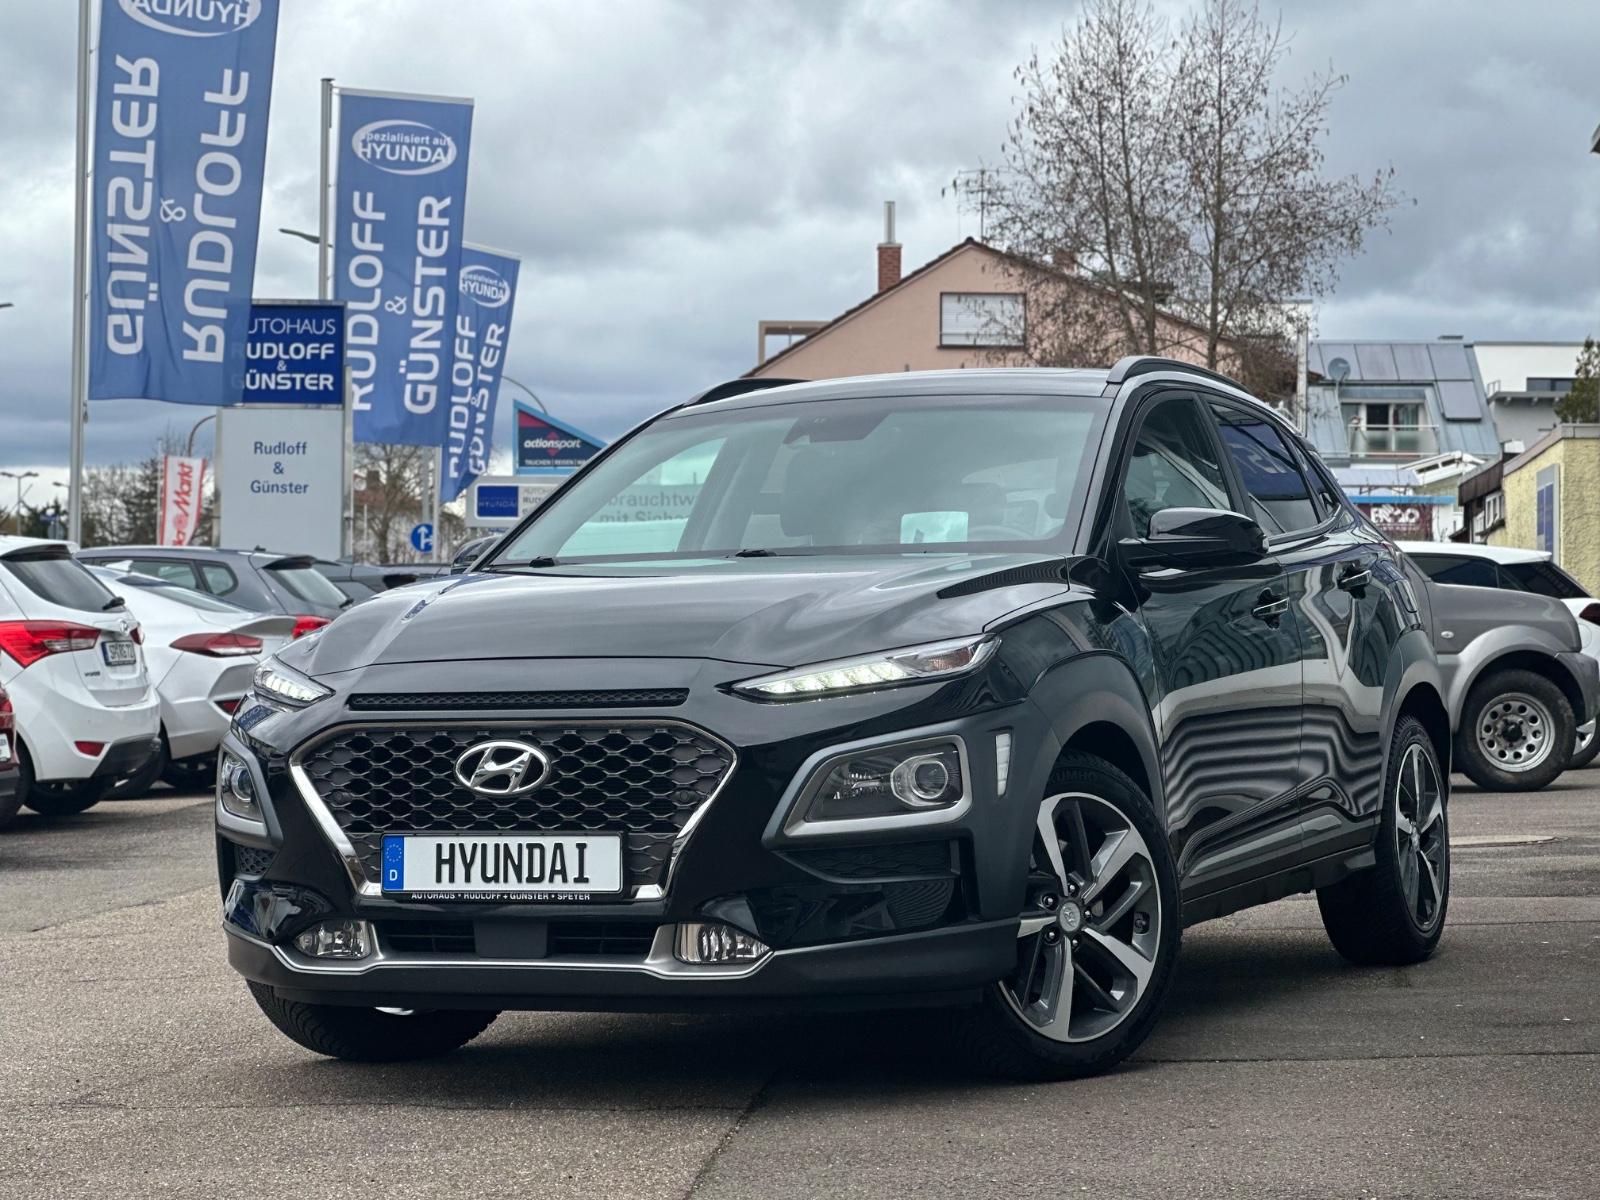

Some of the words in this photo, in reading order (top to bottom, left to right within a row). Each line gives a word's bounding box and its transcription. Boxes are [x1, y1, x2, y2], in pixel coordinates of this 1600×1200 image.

[346, 190, 386, 411] RUDLOFF
[384, 295, 407, 316] &
[399, 195, 452, 414] GÜNSTER
[247, 318, 336, 335] UTOHAUS
[245, 342, 335, 360] UDLOFF
[276, 359, 287, 372] &
[244, 368, 334, 391] ÜNSTER
[253, 441, 307, 455] Rudloff
[523, 437, 582, 450] actionsport
[273, 461, 284, 475] &
[250, 479, 309, 494] Günster
[435, 842, 590, 884] HYUNDAI
[388, 869, 399, 882] D
[557, 892, 590, 901] SPEYER
